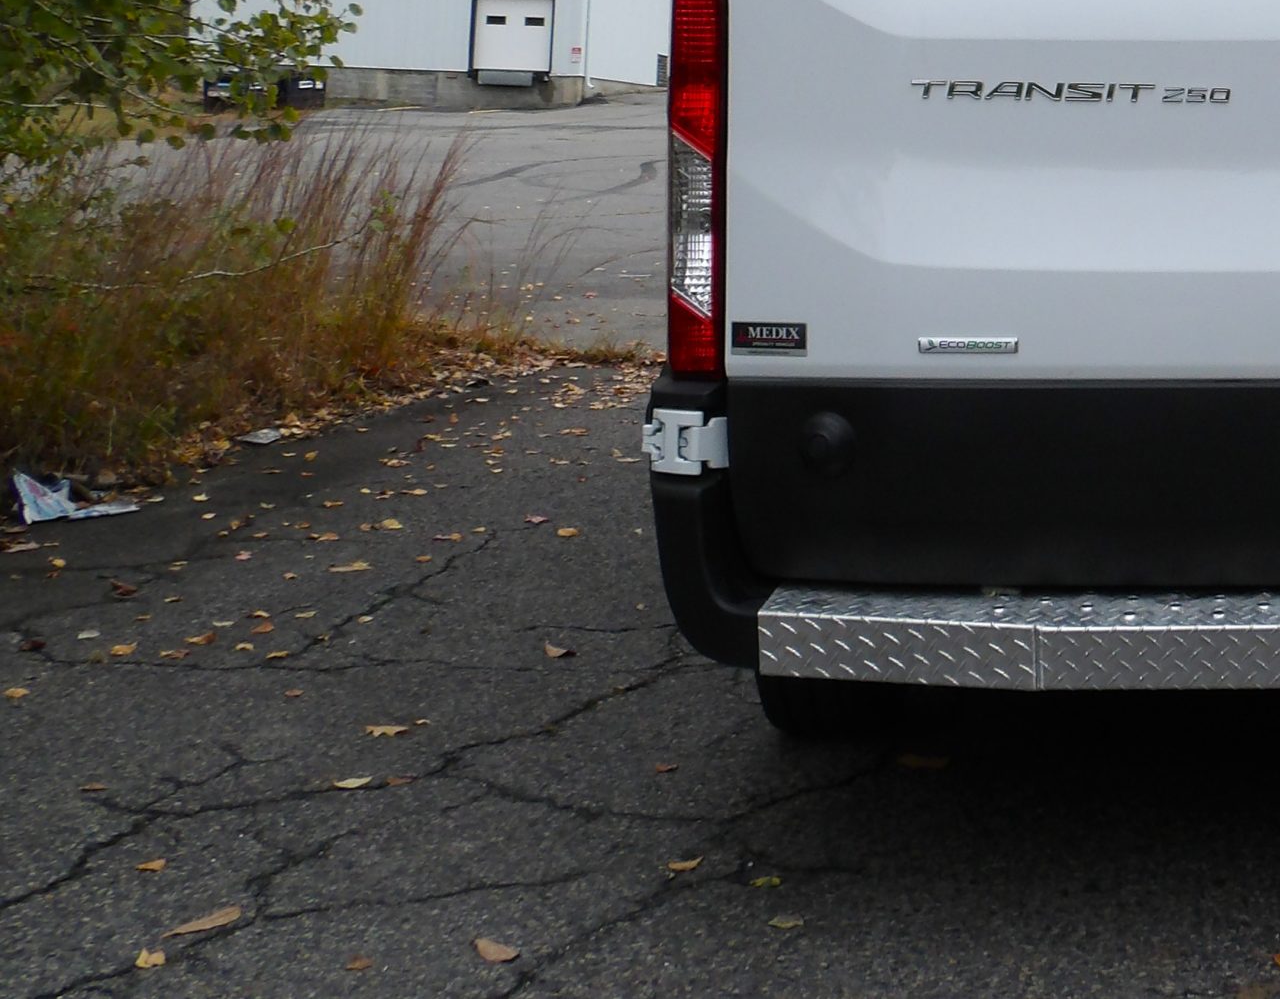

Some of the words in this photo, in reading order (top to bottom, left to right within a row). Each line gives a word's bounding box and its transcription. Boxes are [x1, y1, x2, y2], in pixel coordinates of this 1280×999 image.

[911, 79, 1155, 103] TRANSIT
[1162, 87, 1231, 103] 250
[748, 327, 800, 339] MEDIX
